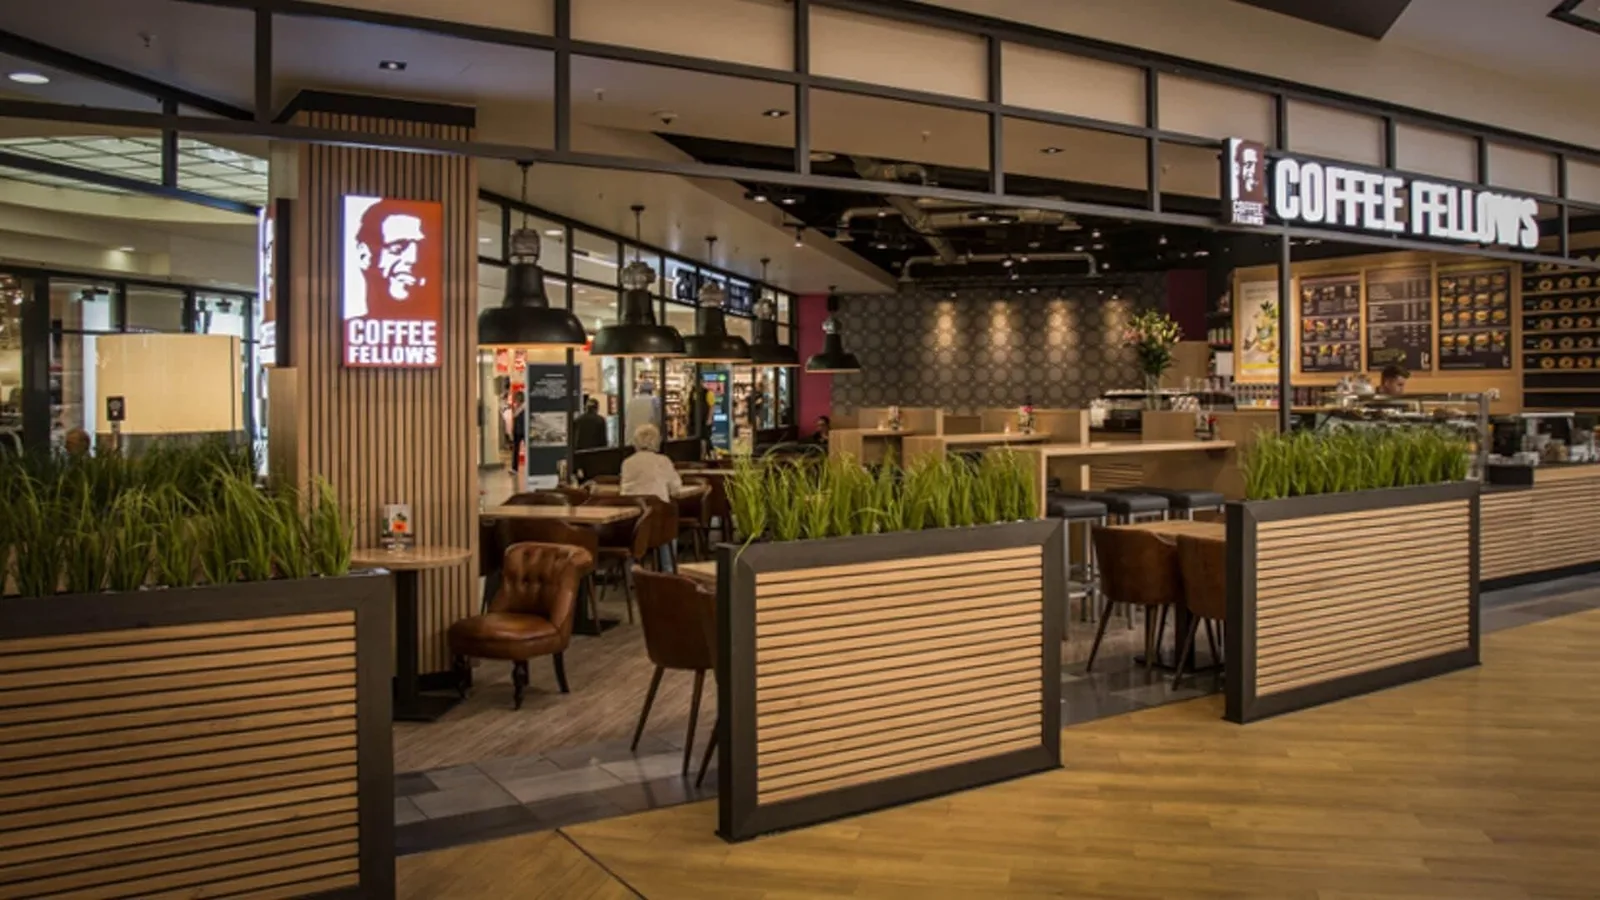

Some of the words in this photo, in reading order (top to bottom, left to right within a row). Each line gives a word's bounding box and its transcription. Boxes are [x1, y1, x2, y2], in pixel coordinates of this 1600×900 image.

[1275, 158, 1405, 232] COFFEE
[1410, 180, 1539, 249] FELLOWS
[348, 319, 437, 346] COFFEE
[348, 346, 437, 364] FELLOWS
